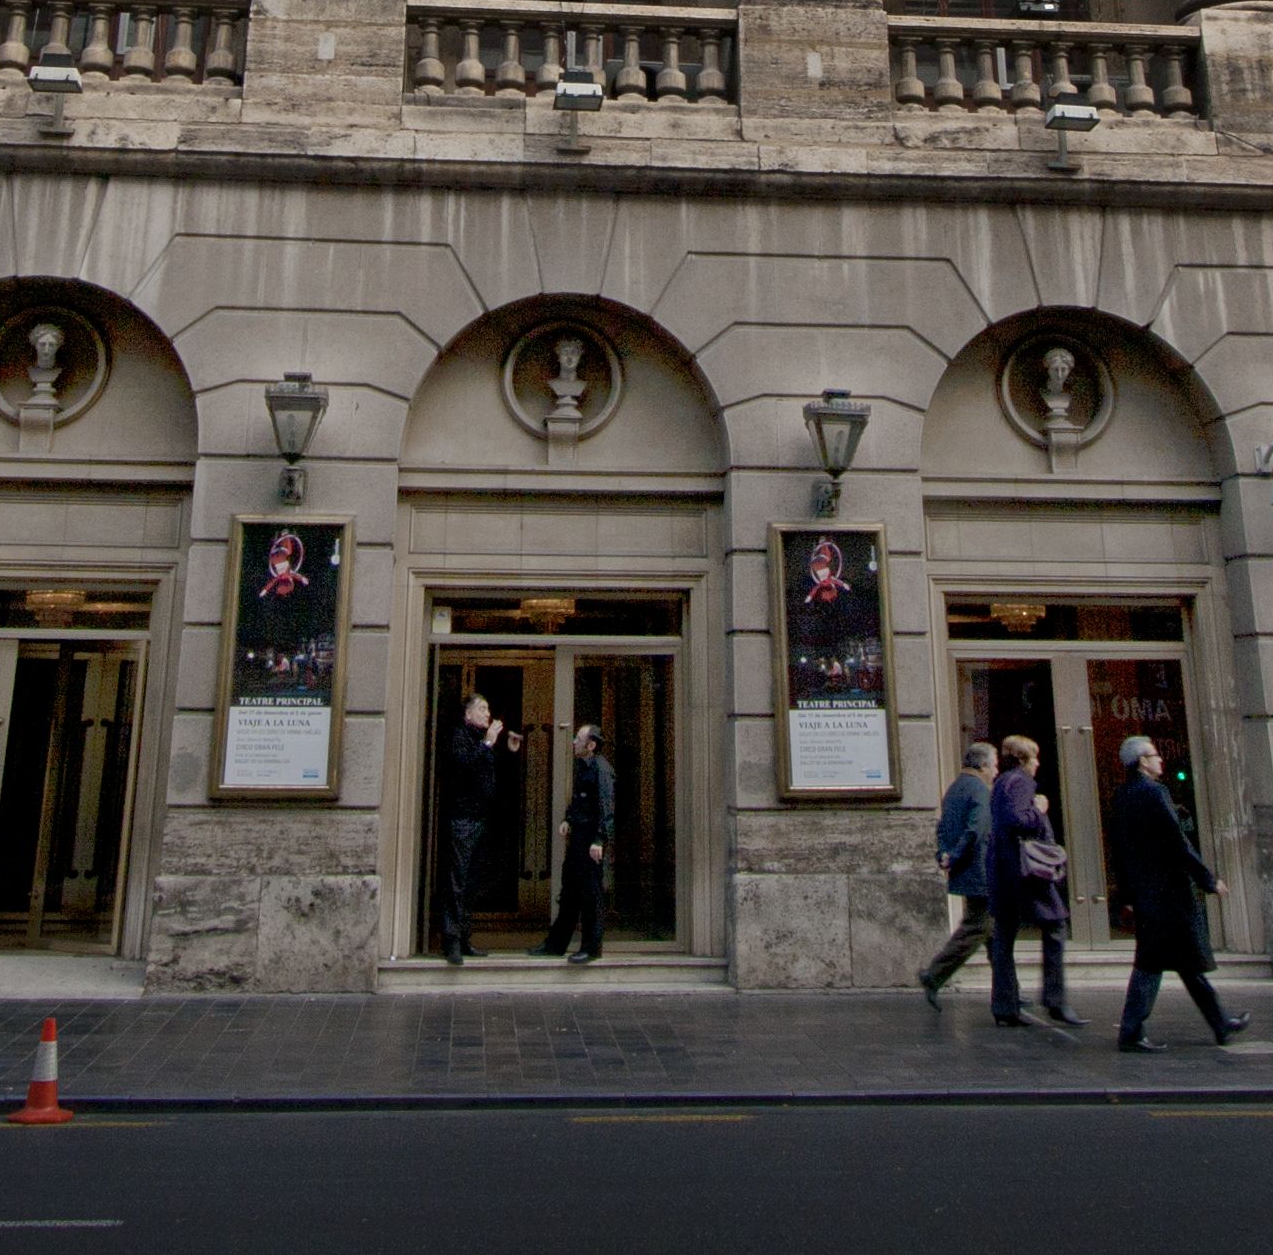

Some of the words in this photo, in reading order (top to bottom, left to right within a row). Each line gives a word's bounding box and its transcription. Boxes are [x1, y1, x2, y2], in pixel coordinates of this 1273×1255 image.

[238, 697, 275, 706] TEATRE
[277, 697, 323, 706] PRINCIPAL
[798, 700, 831, 708] TEATRE
[833, 700, 878, 708] PRINCIPAL
